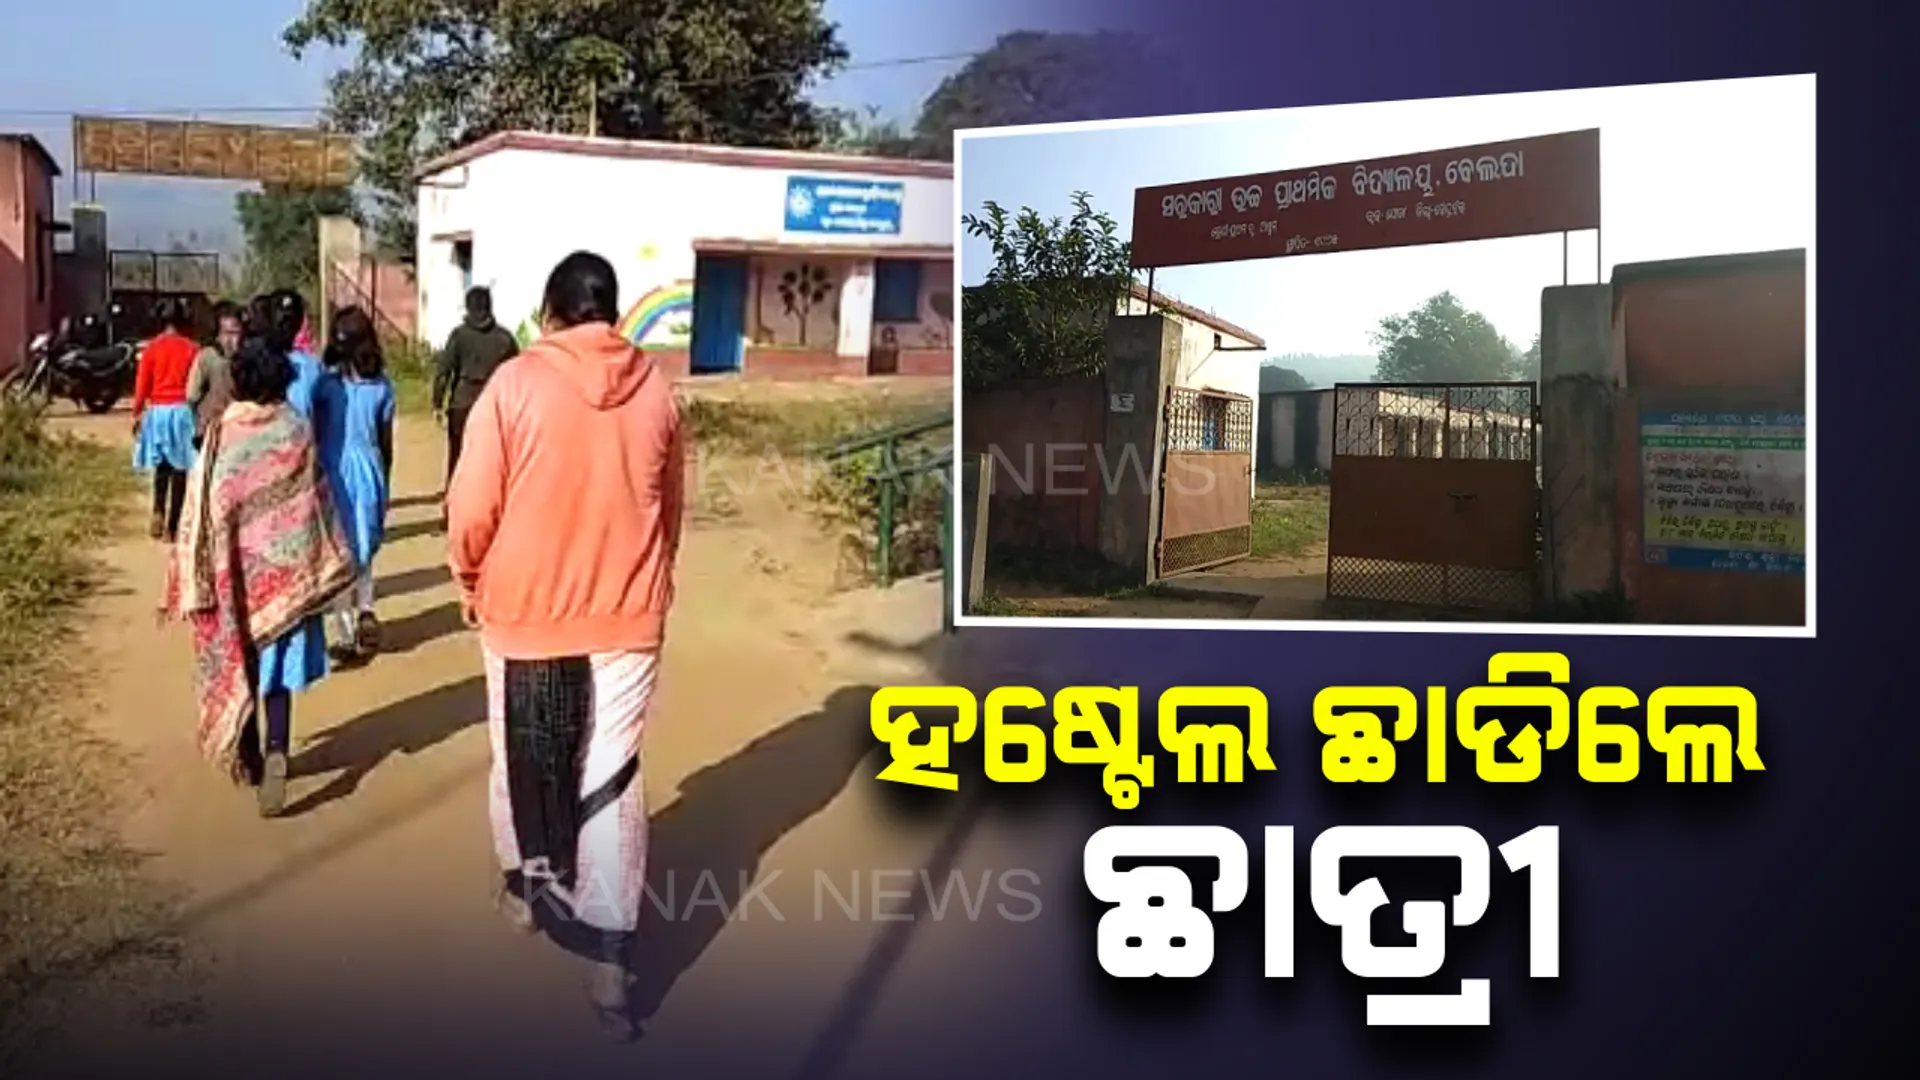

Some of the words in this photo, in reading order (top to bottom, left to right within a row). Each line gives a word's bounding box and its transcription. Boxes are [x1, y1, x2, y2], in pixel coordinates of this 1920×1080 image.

[1161, 187, 1222, 219] ସରକାରୀ
[1274, 171, 1337, 210] ପ୍ରାଥମିକ
[1445, 151, 1524, 185] ବେଲଦା
